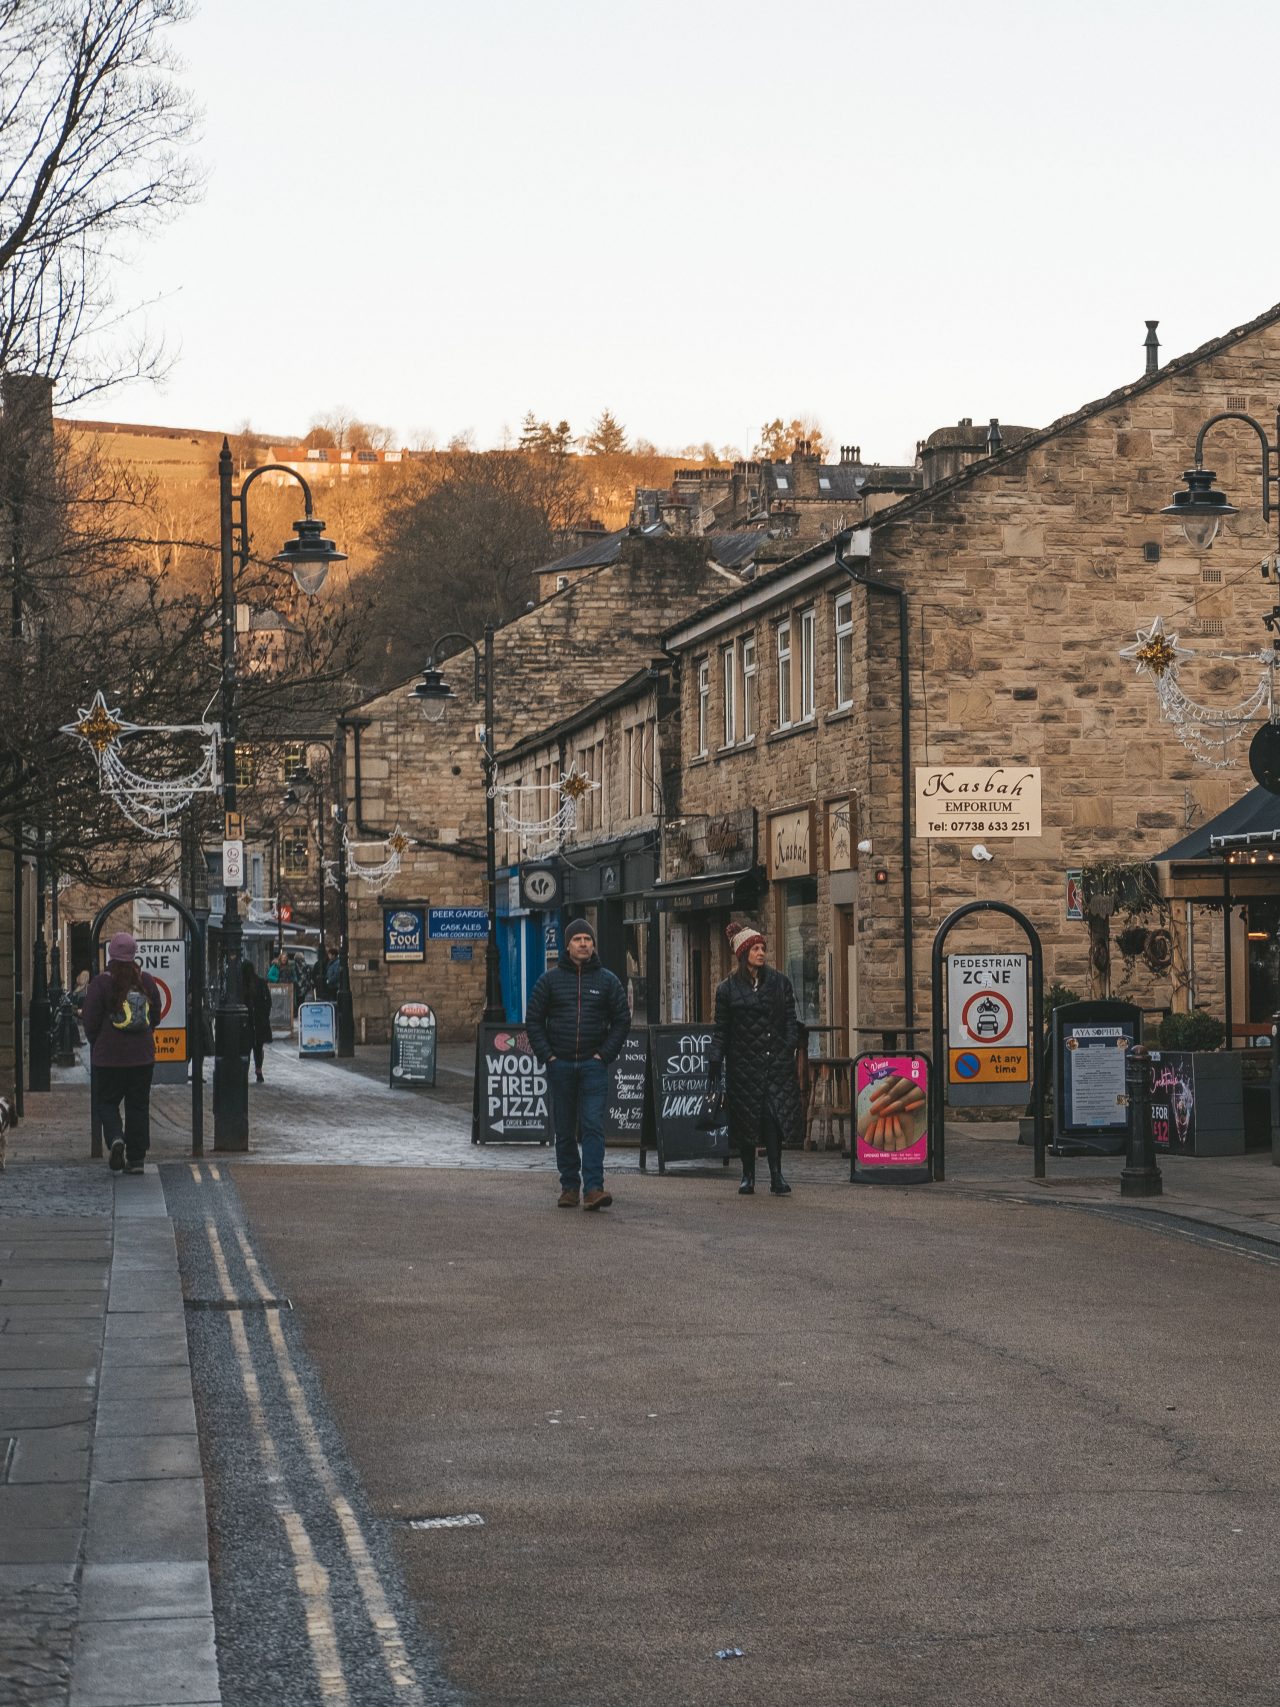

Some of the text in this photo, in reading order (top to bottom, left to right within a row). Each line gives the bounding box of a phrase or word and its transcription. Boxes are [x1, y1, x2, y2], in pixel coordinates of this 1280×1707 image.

[923, 770, 1034, 796] Kasbah
[945, 802, 1012, 812] EMPORIUM
[928, 822, 1030, 831] Tel: 07738 633 251
[774, 819, 810, 870] Kasbah
[432, 910, 454, 918] BEER
[440, 923, 481, 931] CASK ALES
[389, 929, 420, 945] Food
[136, 945, 180, 954] ESTRIAN
[135, 956, 170, 968] ONE
[953, 959, 1022, 968] PEDESTRIAN
[1092, 1028, 1121, 1036] SOPHIA
[990, 1055, 1022, 1064] At any
[485, 1055, 547, 1075] WOOD
[995, 1065, 1017, 1074] time
[487, 1076, 548, 1095] FIRED
[488, 1097, 549, 1117] PIZZA
[1155, 1107, 1168, 1119] FOR
